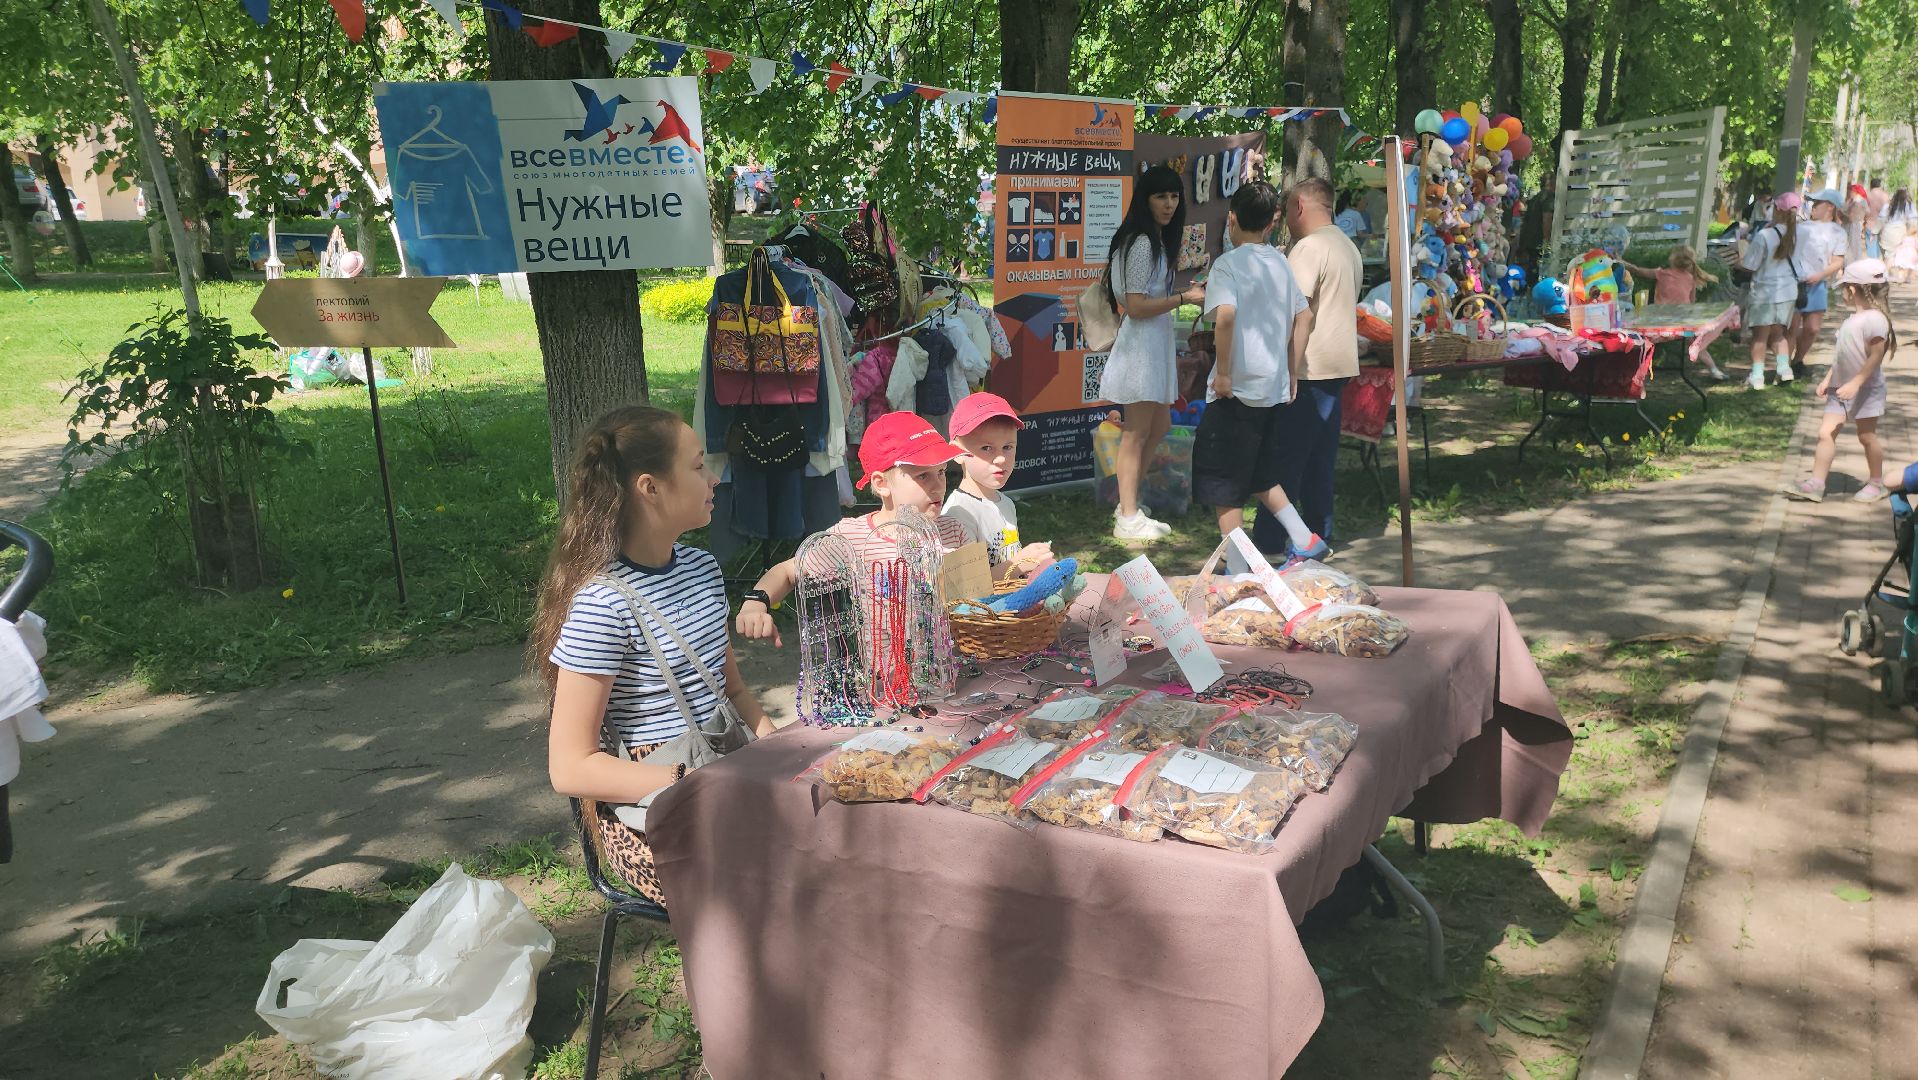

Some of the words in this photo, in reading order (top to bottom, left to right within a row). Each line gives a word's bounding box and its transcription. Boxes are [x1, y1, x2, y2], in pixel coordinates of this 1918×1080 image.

[1009, 151, 1078, 171] НУЖНЫЕ
[513, 172, 548, 180] союз
[653, 166, 696, 176] семей
[1010, 176, 1080, 190] принимаем:
[516, 187, 683, 231] Нужные
[523, 235, 631, 267] вещи
[1007, 268, 1072, 282] ОКАЗЫВАЕМ
[317, 309, 334, 322] За
[337, 312, 380, 322] жизнь
